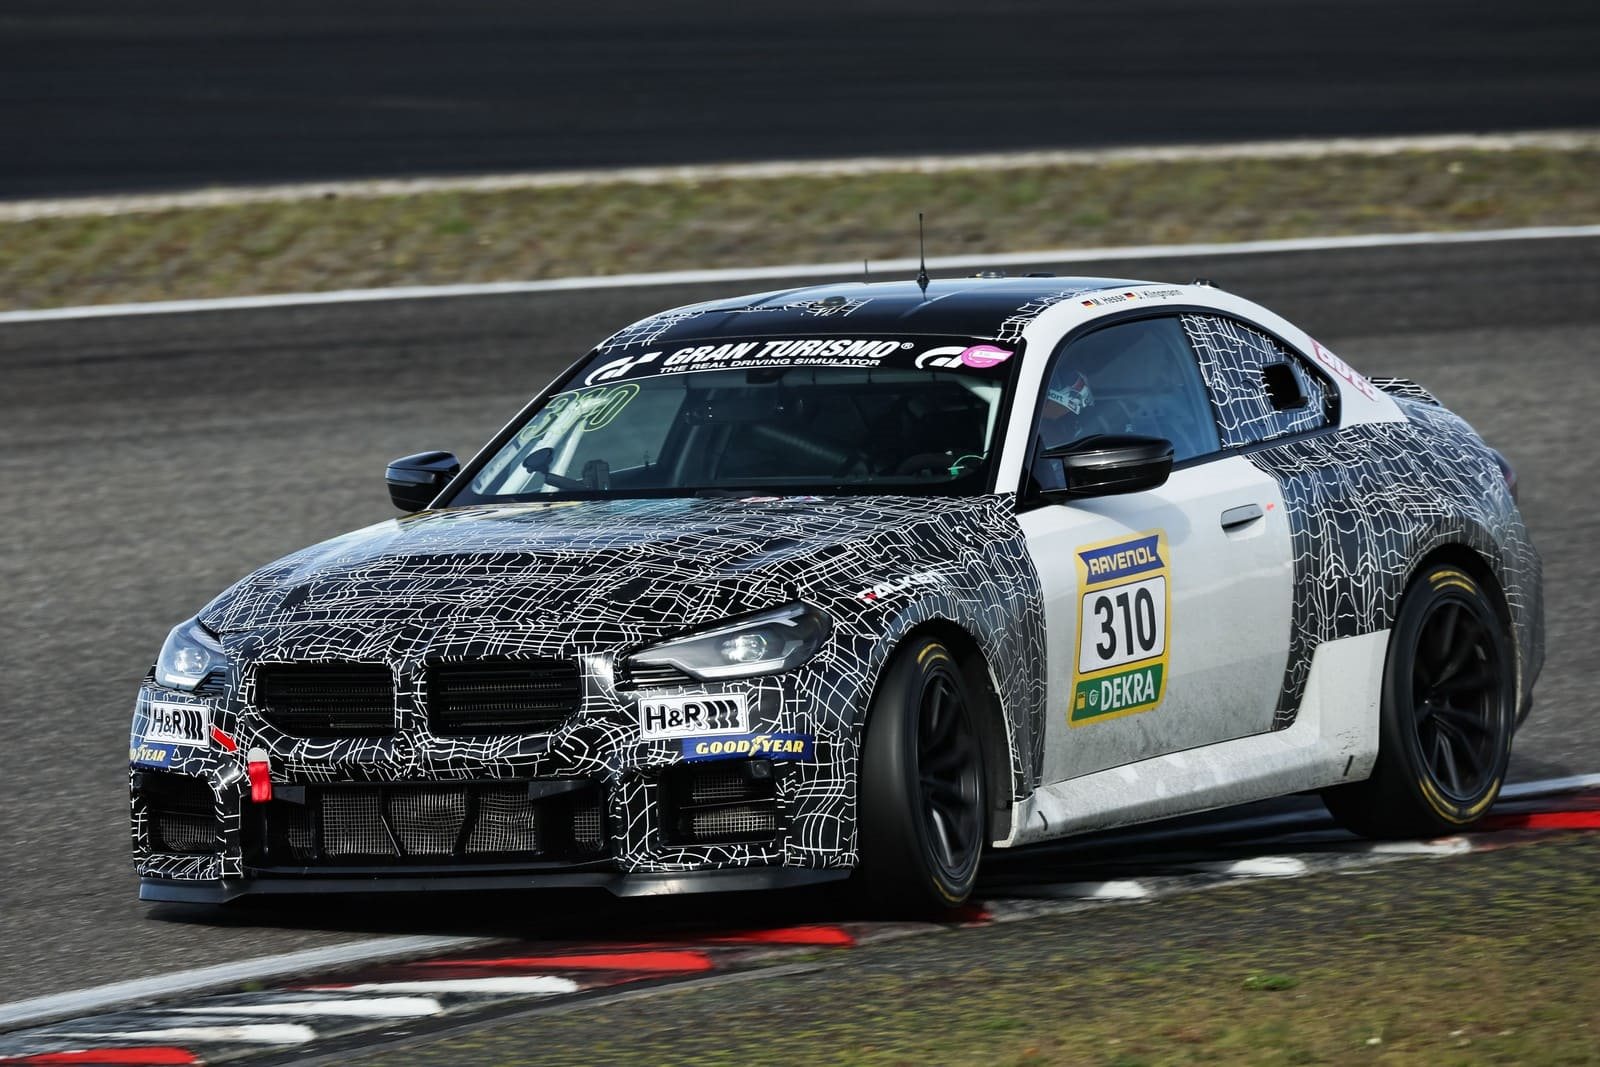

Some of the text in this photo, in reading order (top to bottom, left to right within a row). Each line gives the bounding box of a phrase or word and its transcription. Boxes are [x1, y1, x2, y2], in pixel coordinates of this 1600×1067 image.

[660, 358, 881, 374] THE REAL DRIVING SIMULATOR
[664, 342, 759, 366] GRAN
[1088, 546, 1157, 576] RAVENOL
[1094, 587, 1157, 660] 310
[1100, 670, 1155, 711] DEKRA
[151, 708, 183, 734] H&R
[645, 703, 702, 731] H&R
[695, 736, 805, 756] GOODYEAR
